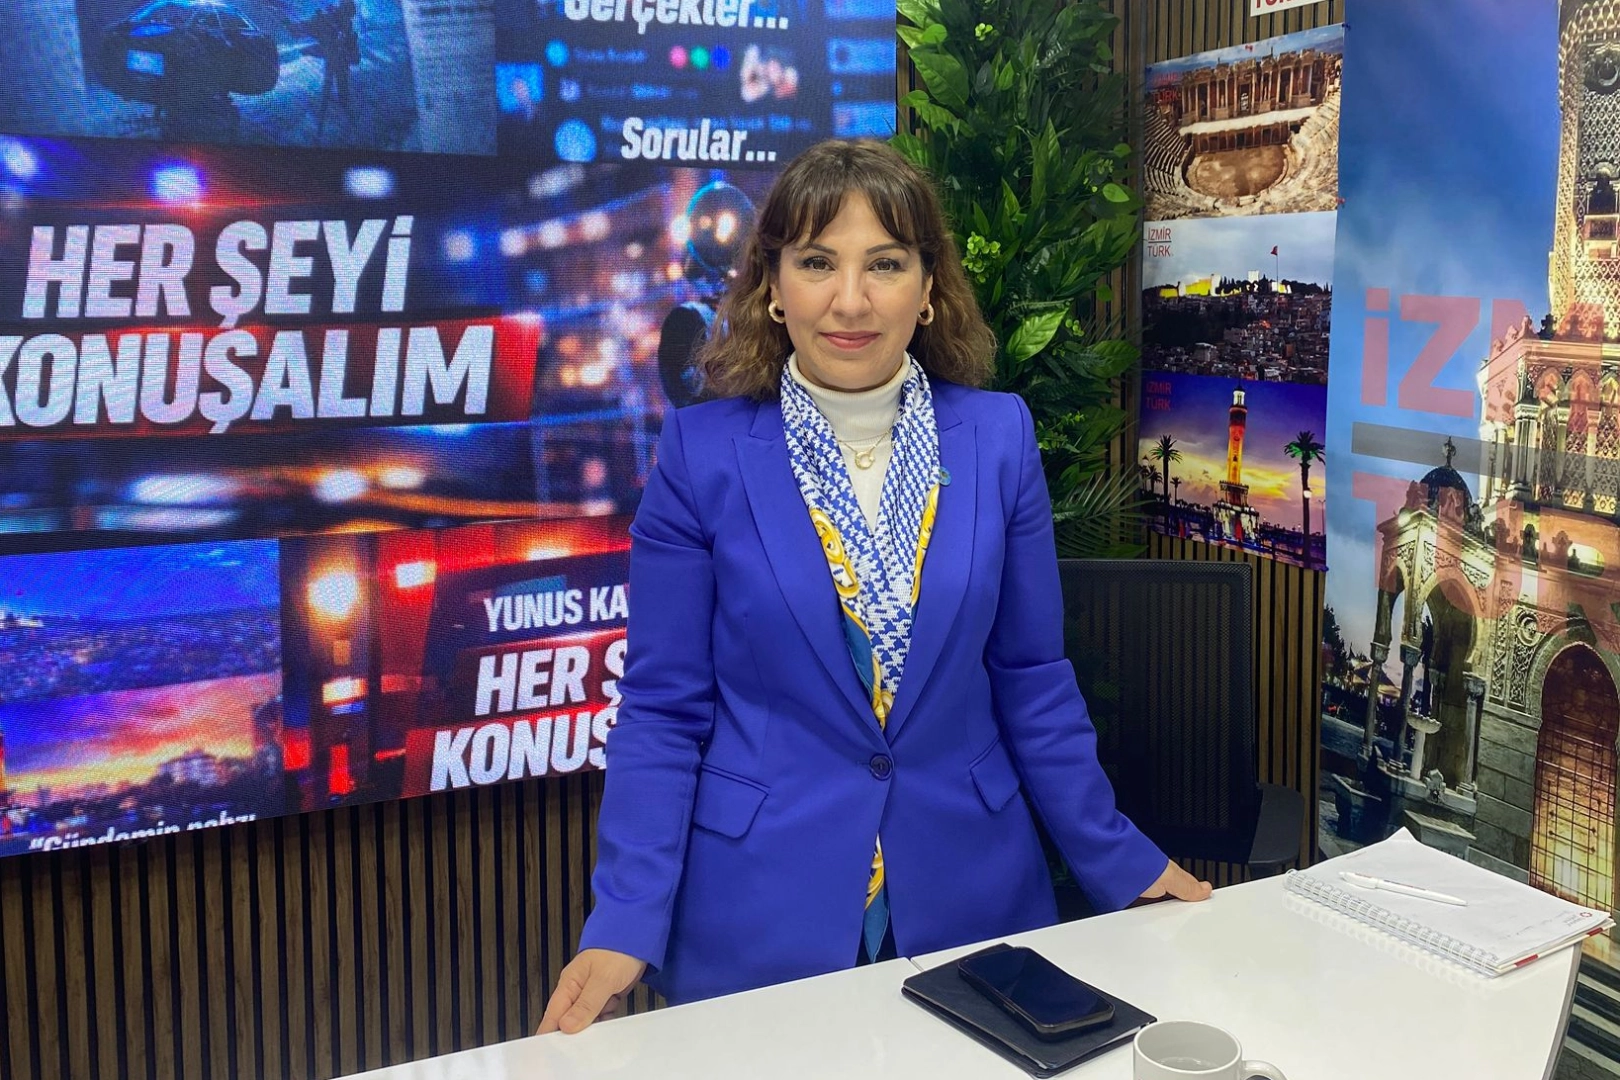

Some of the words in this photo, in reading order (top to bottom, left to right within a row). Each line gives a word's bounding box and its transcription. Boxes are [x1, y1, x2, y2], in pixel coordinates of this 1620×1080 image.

[620, 117, 777, 161] Sorular...
[22, 223, 195, 318] HER
[209, 215, 414, 327] ŞEYİ
[483, 589, 584, 632] YUNUS
[475, 645, 590, 716] HER
